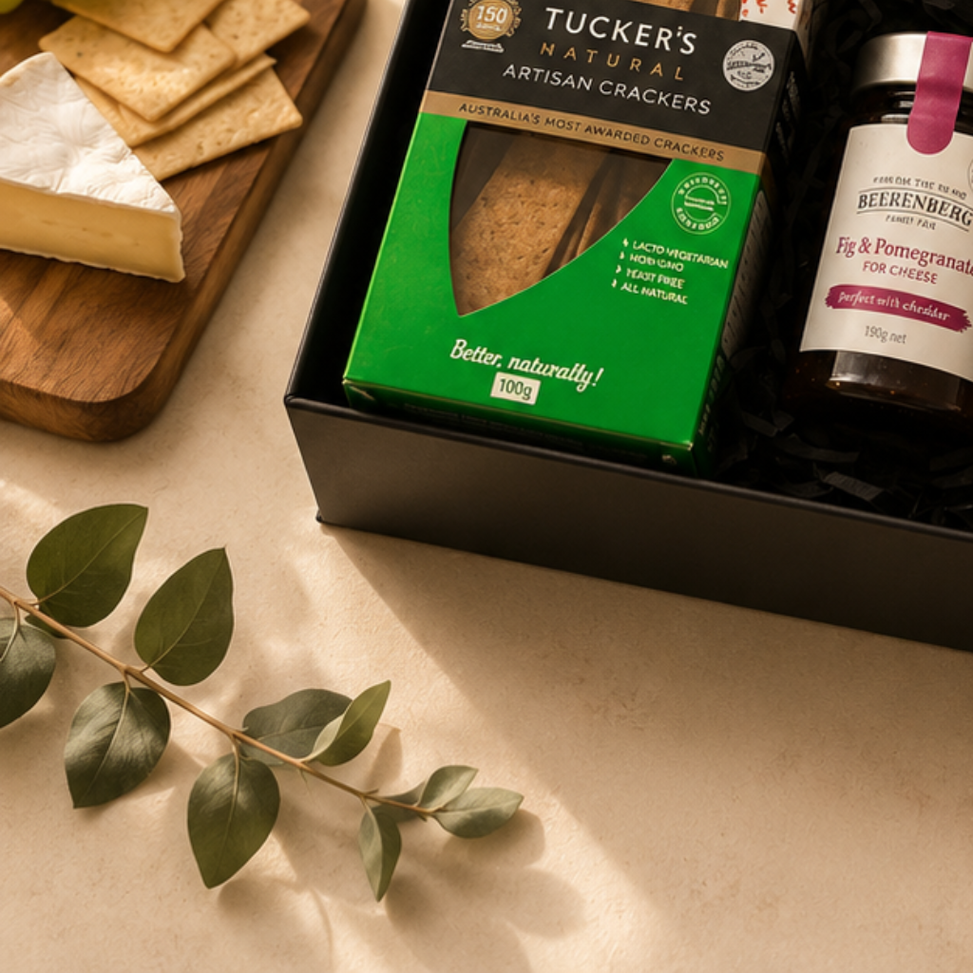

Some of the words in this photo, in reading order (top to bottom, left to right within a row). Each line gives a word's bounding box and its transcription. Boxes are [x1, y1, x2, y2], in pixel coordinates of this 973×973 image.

[477, 5, 509, 24] 150
[545, 7, 697, 55] TUCKER'S
[540, 42, 684, 82] NATURAL
[502, 63, 592, 91] ARTISAN
[599, 80, 712, 115] CRACKERS
[459, 103, 541, 125] AUSTRALIA'S
[544, 117, 581, 132] MOST
[584, 125, 651, 145] AWARDED
[654, 137, 724, 162] CRACKERS
[857, 191, 973, 226] BEERENBERG
[633, 241, 665, 254] LACTO
[836, 236, 857, 258] Fig
[858, 236, 872, 254] &
[862, 260, 886, 274] FOR
[889, 264, 938, 284] CHEESE
[620, 282, 639, 294] ALL
[838, 290, 875, 307] perfect
[864, 325, 889, 344] 190g
[889, 332, 907, 344] net
[507, 356, 604, 393] naturally!
[499, 378, 533, 401] 100g
